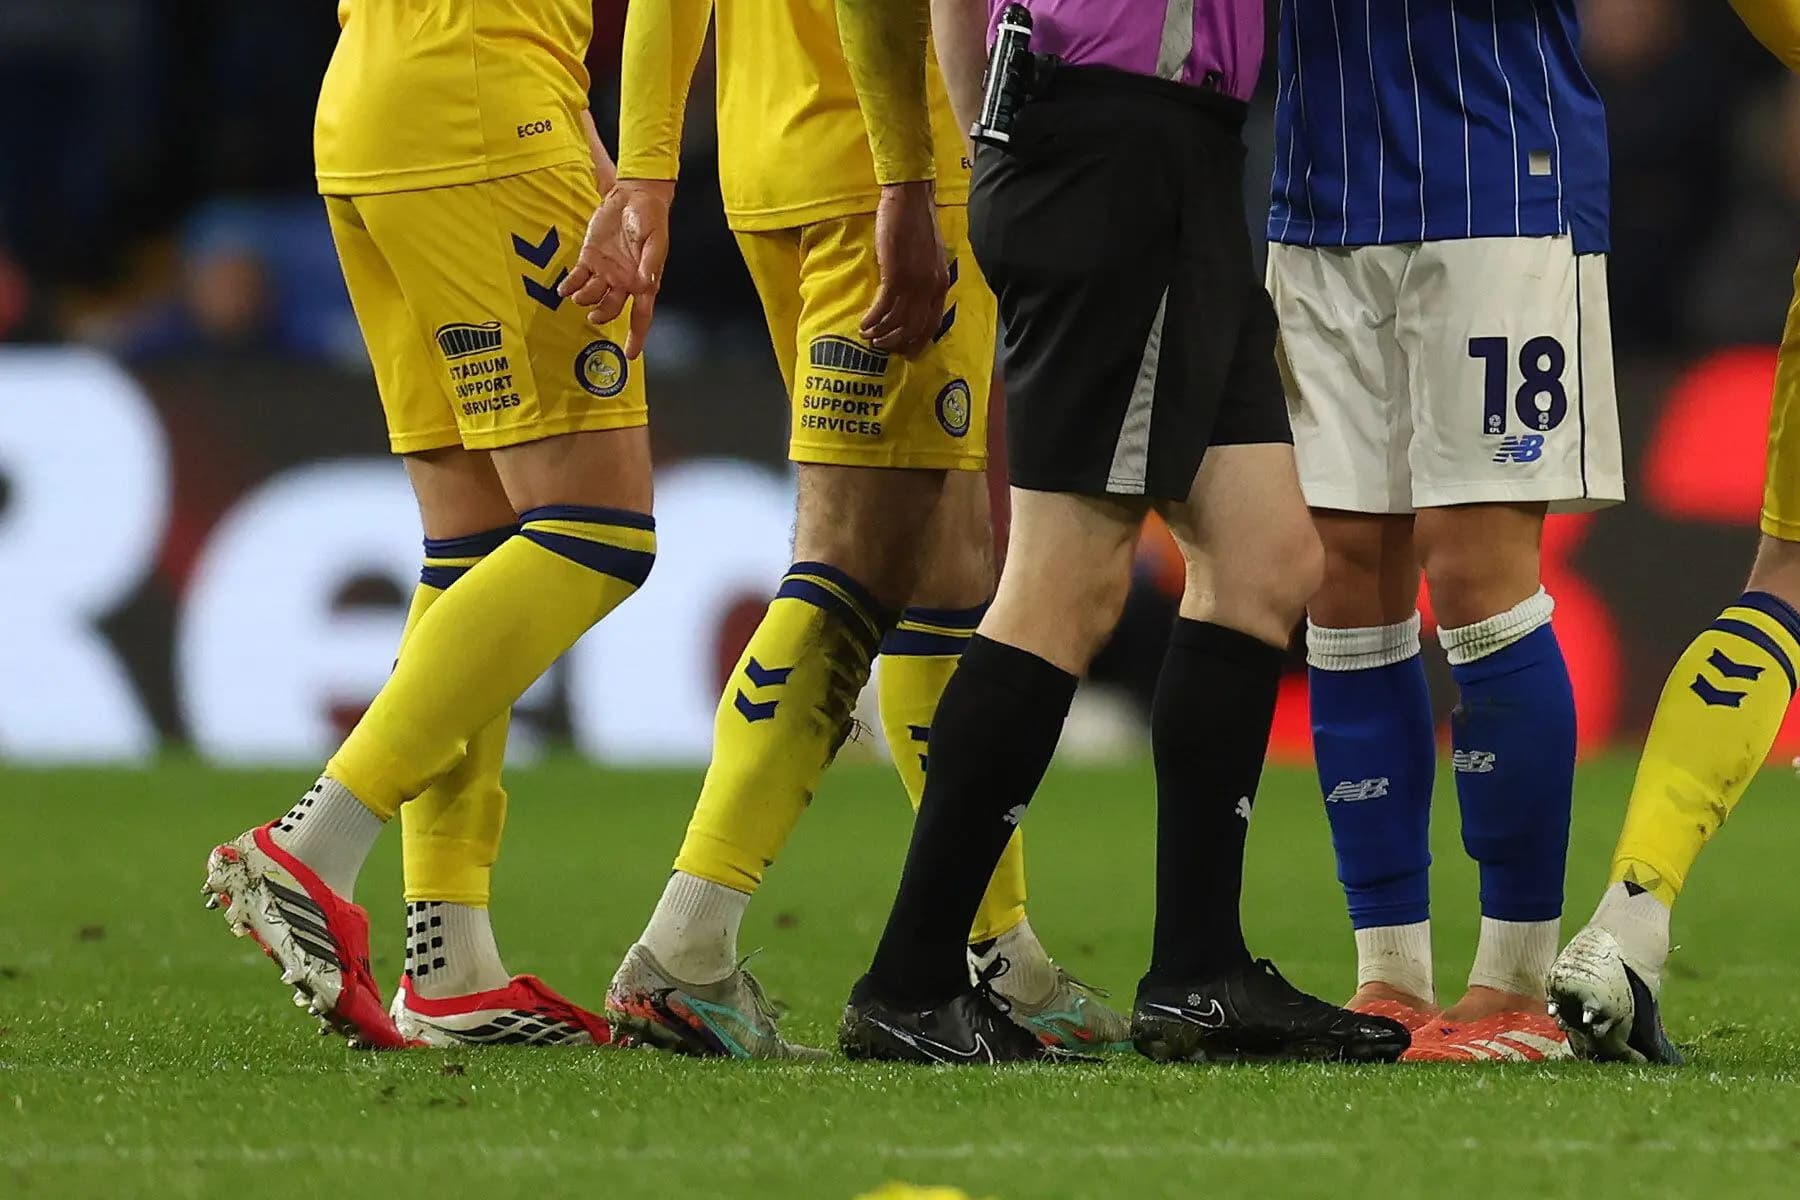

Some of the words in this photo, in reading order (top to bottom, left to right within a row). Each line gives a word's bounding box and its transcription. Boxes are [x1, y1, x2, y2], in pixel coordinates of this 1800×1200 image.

[805, 376, 884, 398] STADIUM
[1468, 335, 1568, 434] 18
[803, 395, 883, 417] SUPPORT
[801, 415, 882, 436] SERVICES
